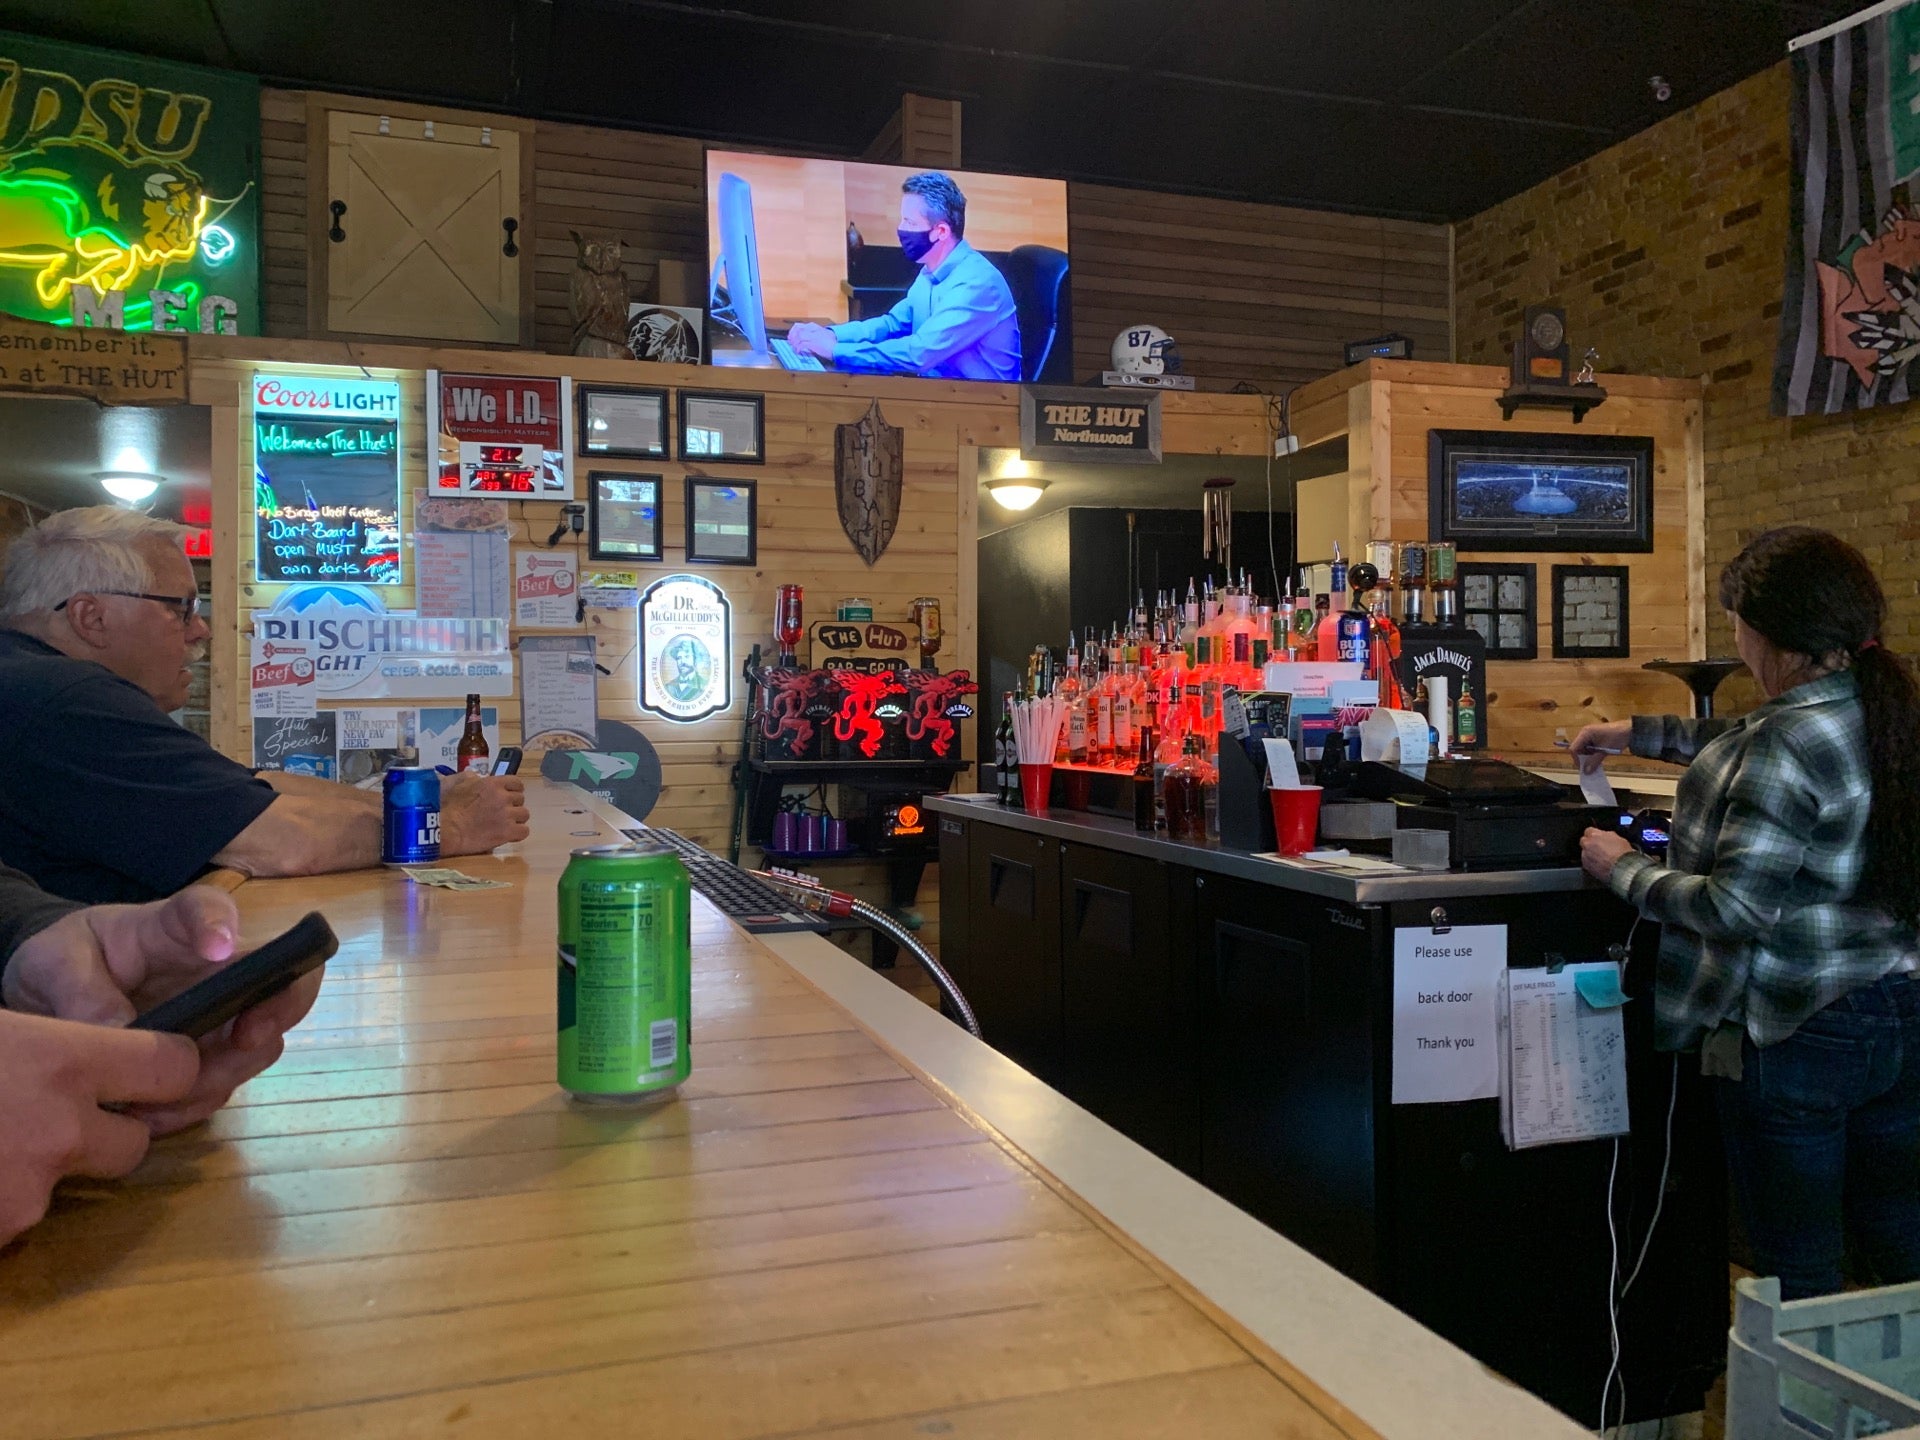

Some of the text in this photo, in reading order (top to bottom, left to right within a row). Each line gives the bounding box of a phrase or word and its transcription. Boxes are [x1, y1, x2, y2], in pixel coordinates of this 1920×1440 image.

[0, 57, 210, 161] DSU
[0, 331, 155, 356] emember it.
[1128, 330, 1151, 347] 87
[19, 364, 46, 383] at
[256, 380, 396, 411] Coors LIGHT
[451, 387, 548, 425] We I.D.
[1044, 405, 1145, 428] THE HUT
[326, 430, 357, 451] The
[359, 429, 395, 451] Hut!
[1053, 428, 1133, 445] Northwood
[511, 473, 530, 490] 16
[283, 506, 320, 522] Bingo
[321, 506, 346, 517] Until
[267, 519, 309, 539] Dart
[311, 521, 357, 539] Board
[273, 542, 384, 559] open MUST use
[280, 561, 360, 575] own darts
[520, 577, 552, 593] Beef
[674, 595, 699, 611] DR.
[823, 628, 903, 647] THE HUT
[1340, 640, 1367, 650] BUD
[317, 655, 367, 671] GHT
[1338, 649, 1370, 660] LIGHT
[1414, 646, 1473, 673] JACK DANIEL'S
[255, 664, 291, 682] Beef
[343, 711, 362, 721] TRY
[945, 704, 973, 716] FIREBALL
[274, 717, 309, 740] Hut
[344, 720, 397, 730] YOUR NEXT
[343, 729, 385, 739] NEW FAV
[263, 728, 328, 758] Special
[343, 739, 369, 748] HERE
[1325, 908, 1366, 931] true
[1415, 946, 1473, 958] Please use
[1417, 990, 1473, 1004] back door
[1416, 1036, 1475, 1050] Thank you
